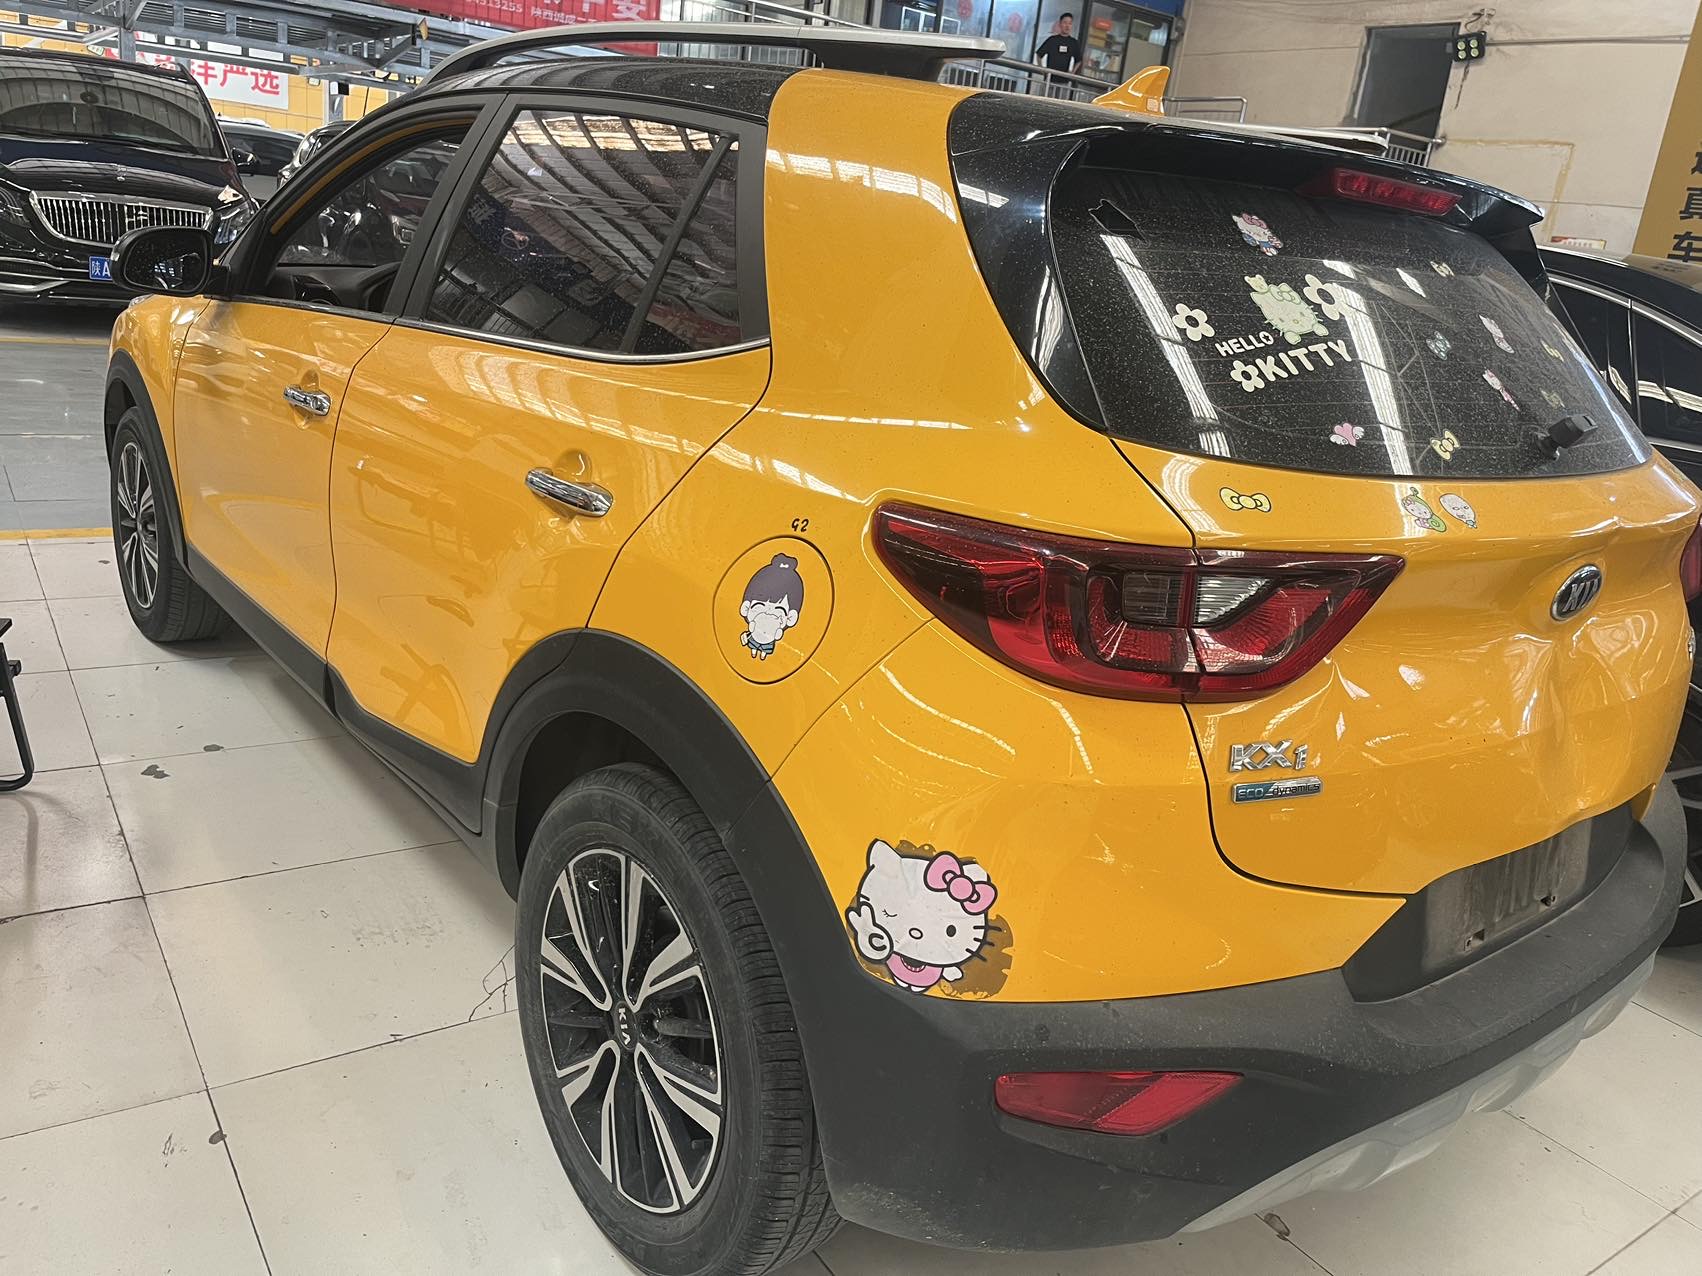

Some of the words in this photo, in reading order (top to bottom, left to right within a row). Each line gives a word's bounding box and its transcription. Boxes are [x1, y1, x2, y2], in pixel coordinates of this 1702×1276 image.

[1214, 331, 1274, 357] HELLO
[1254, 339, 1352, 382] KITTY
[1562, 579, 1599, 612] KIA
[1229, 739, 1309, 772] KX1
[1237, 787, 1264, 799] ECO
[1272, 783, 1320, 798] dynamics
[618, 1007, 631, 1046] KIA
